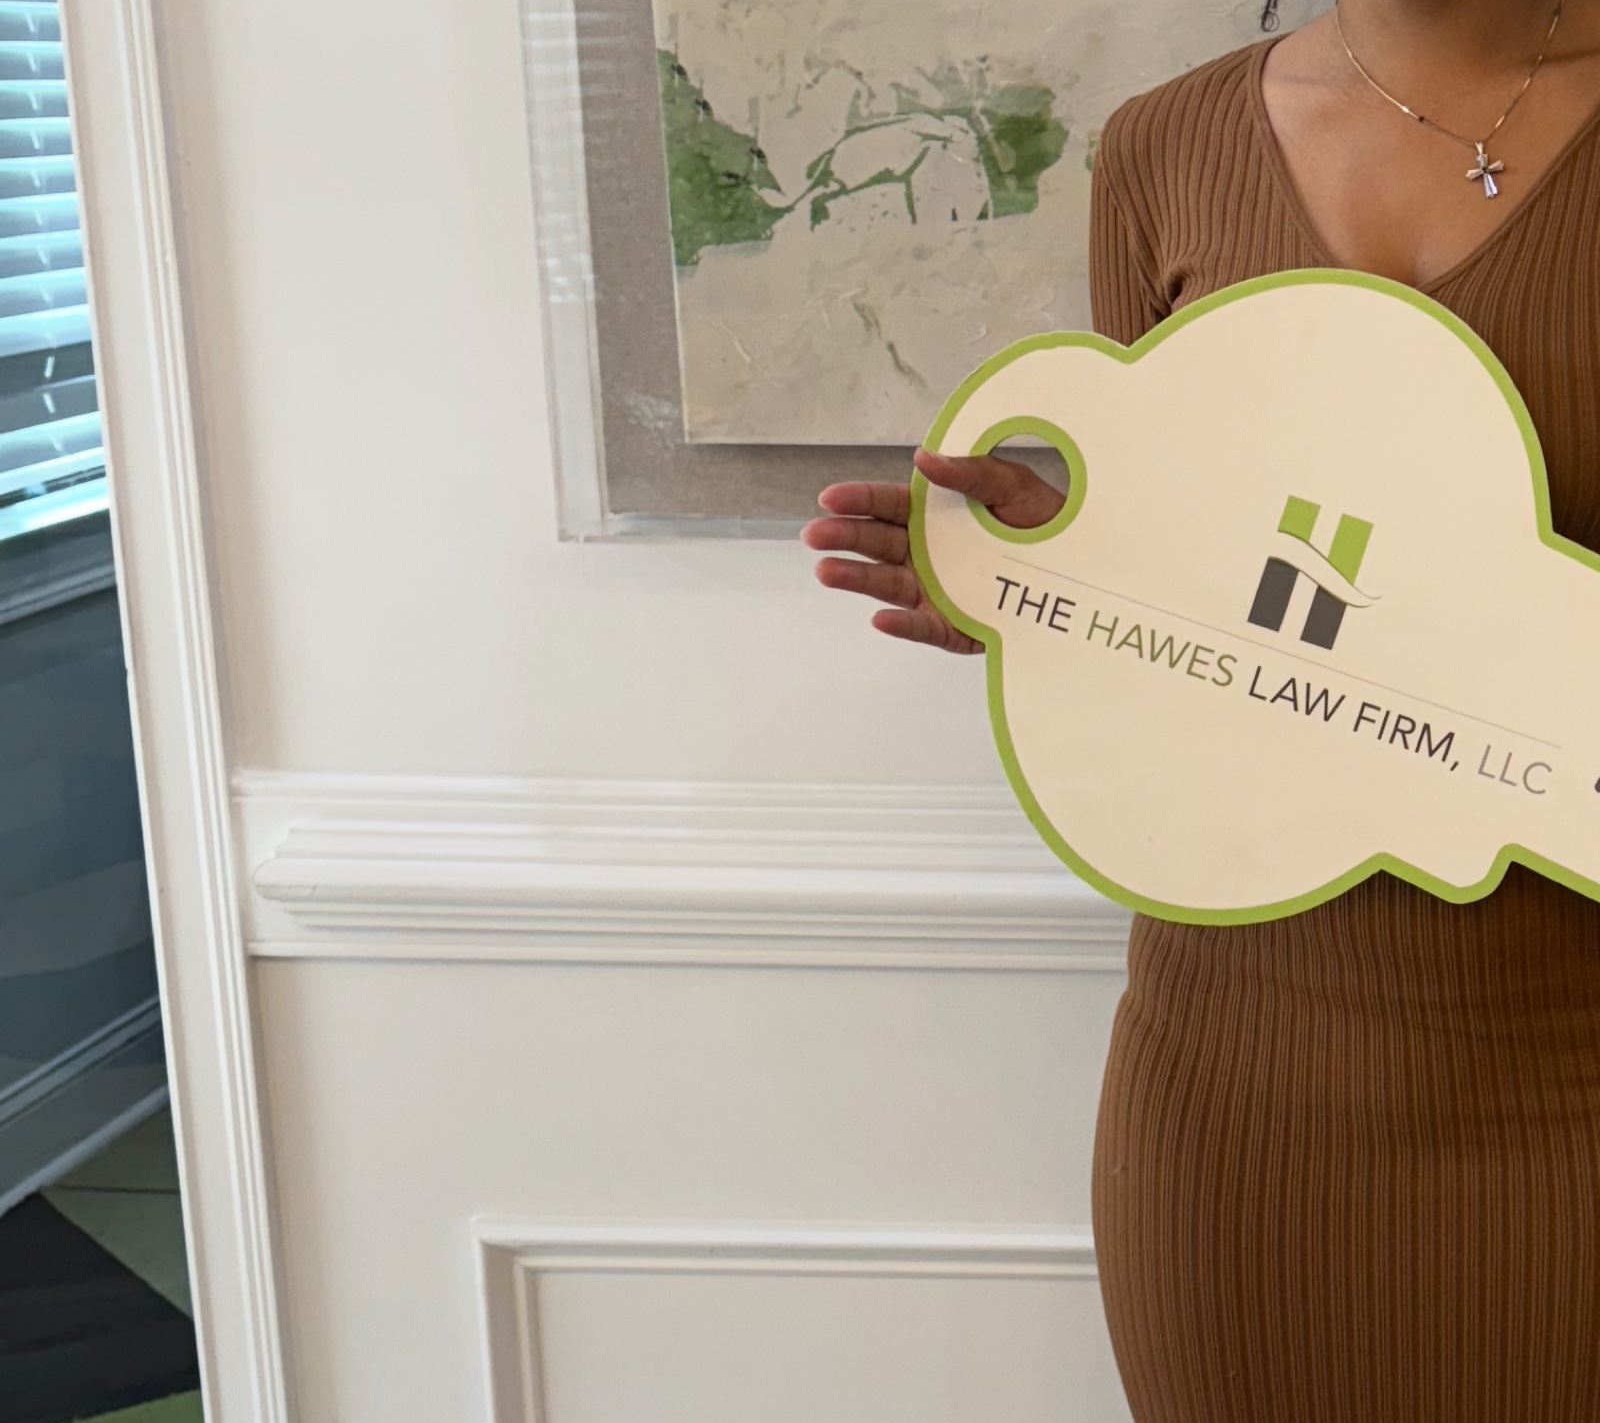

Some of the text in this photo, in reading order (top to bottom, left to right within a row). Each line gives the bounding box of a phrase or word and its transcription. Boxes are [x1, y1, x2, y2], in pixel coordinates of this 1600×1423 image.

[995, 575, 1553, 795] THE HAWES LAW FIRM, LLC
